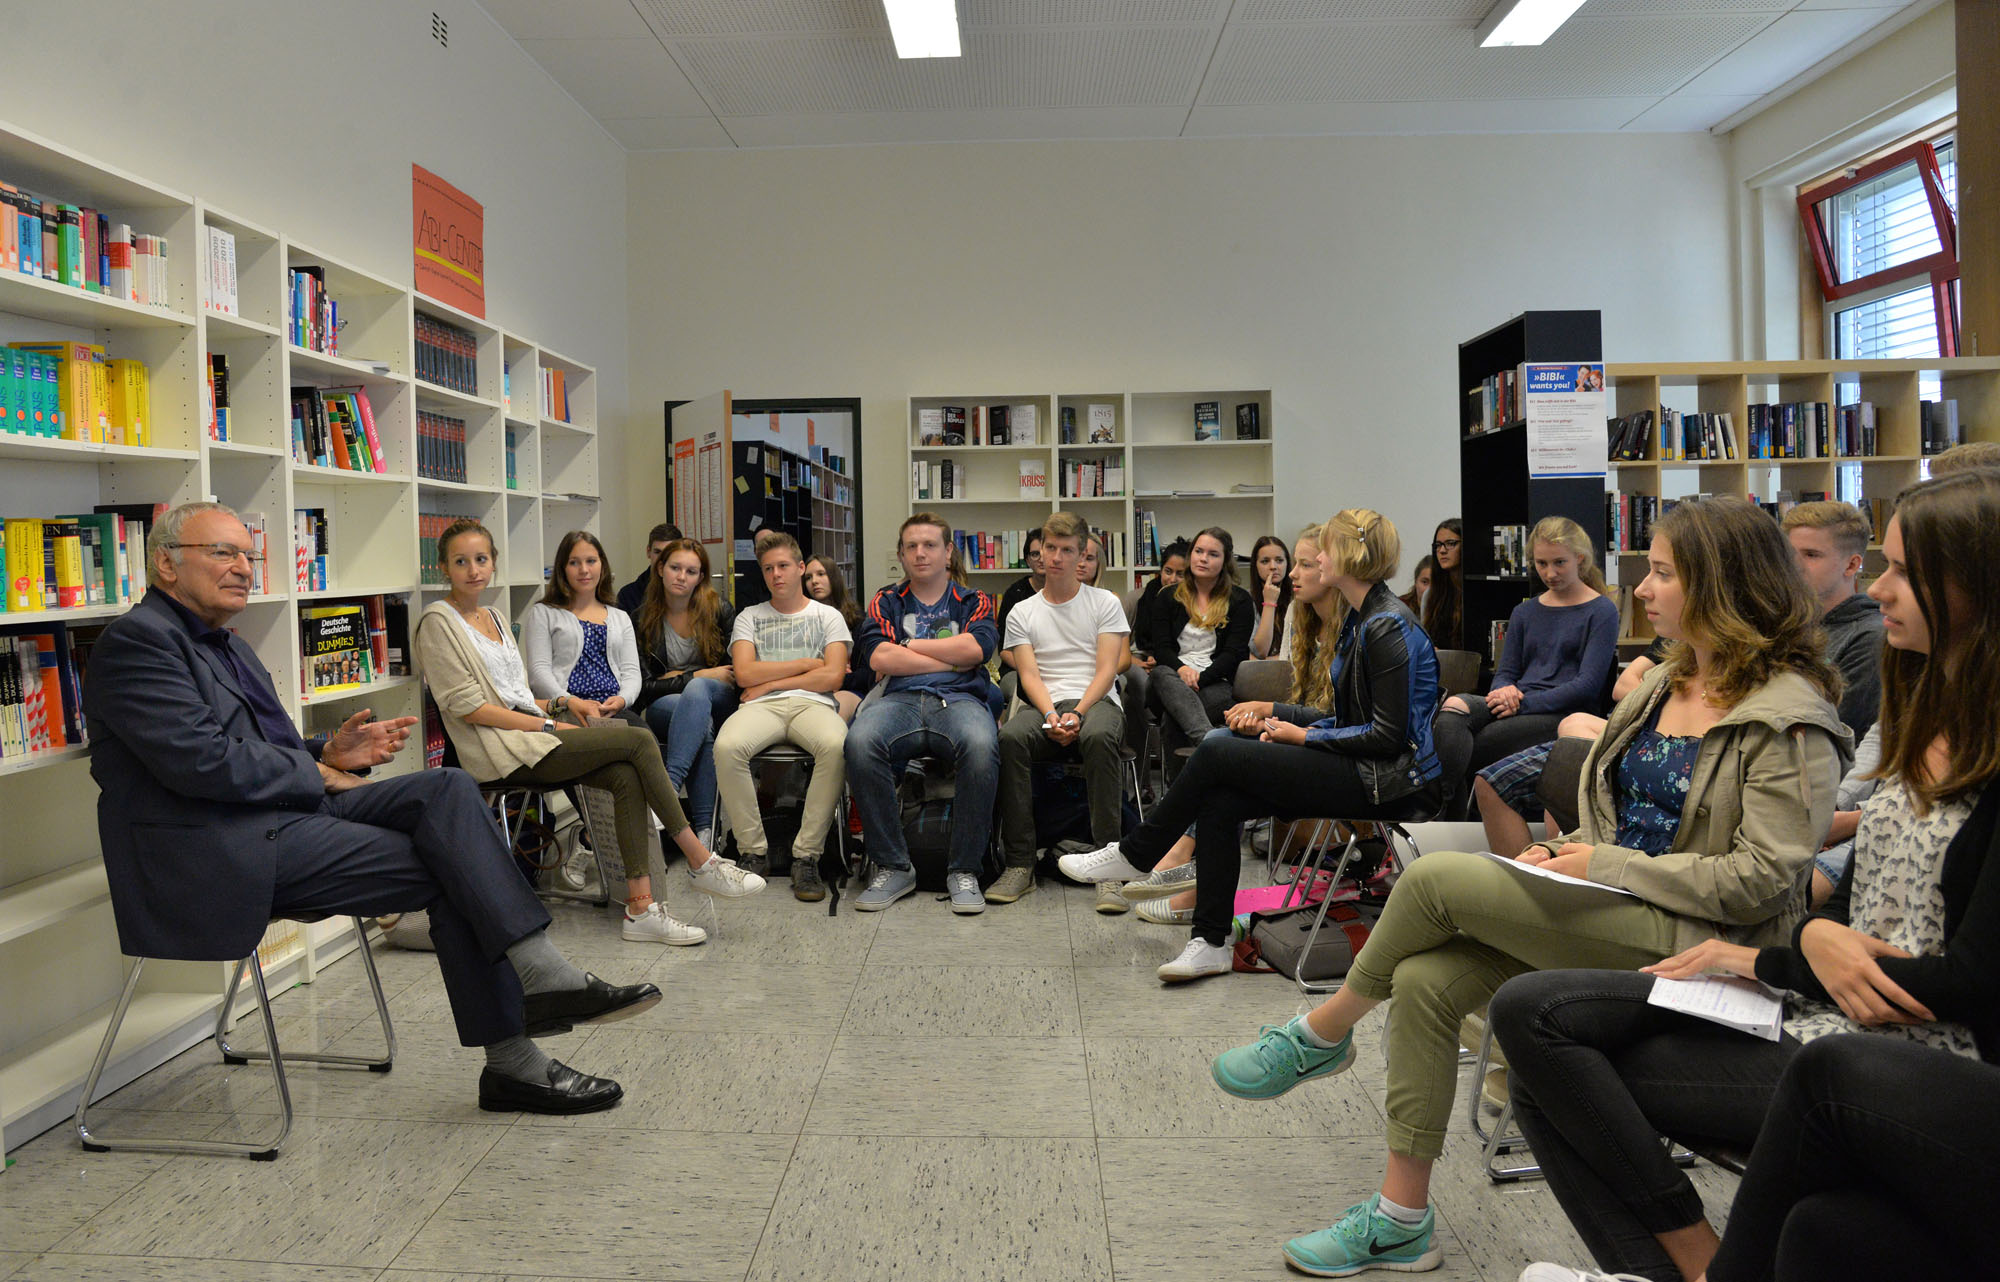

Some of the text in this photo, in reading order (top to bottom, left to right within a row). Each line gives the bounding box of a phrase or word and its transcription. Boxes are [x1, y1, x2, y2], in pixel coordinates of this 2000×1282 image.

[1529, 380, 1571, 390] wants you!
[15, 390, 27, 430] PONS
[31, 391, 44, 431] PONS
[48, 393, 60, 433] PONS
[1094, 409, 1112, 417] 1815
[367, 406, 378, 443] Biologie
[321, 616, 349, 627] Deutsche
[320, 624, 352, 636] Geschichte
[317, 636, 354, 652] DUMMIES
